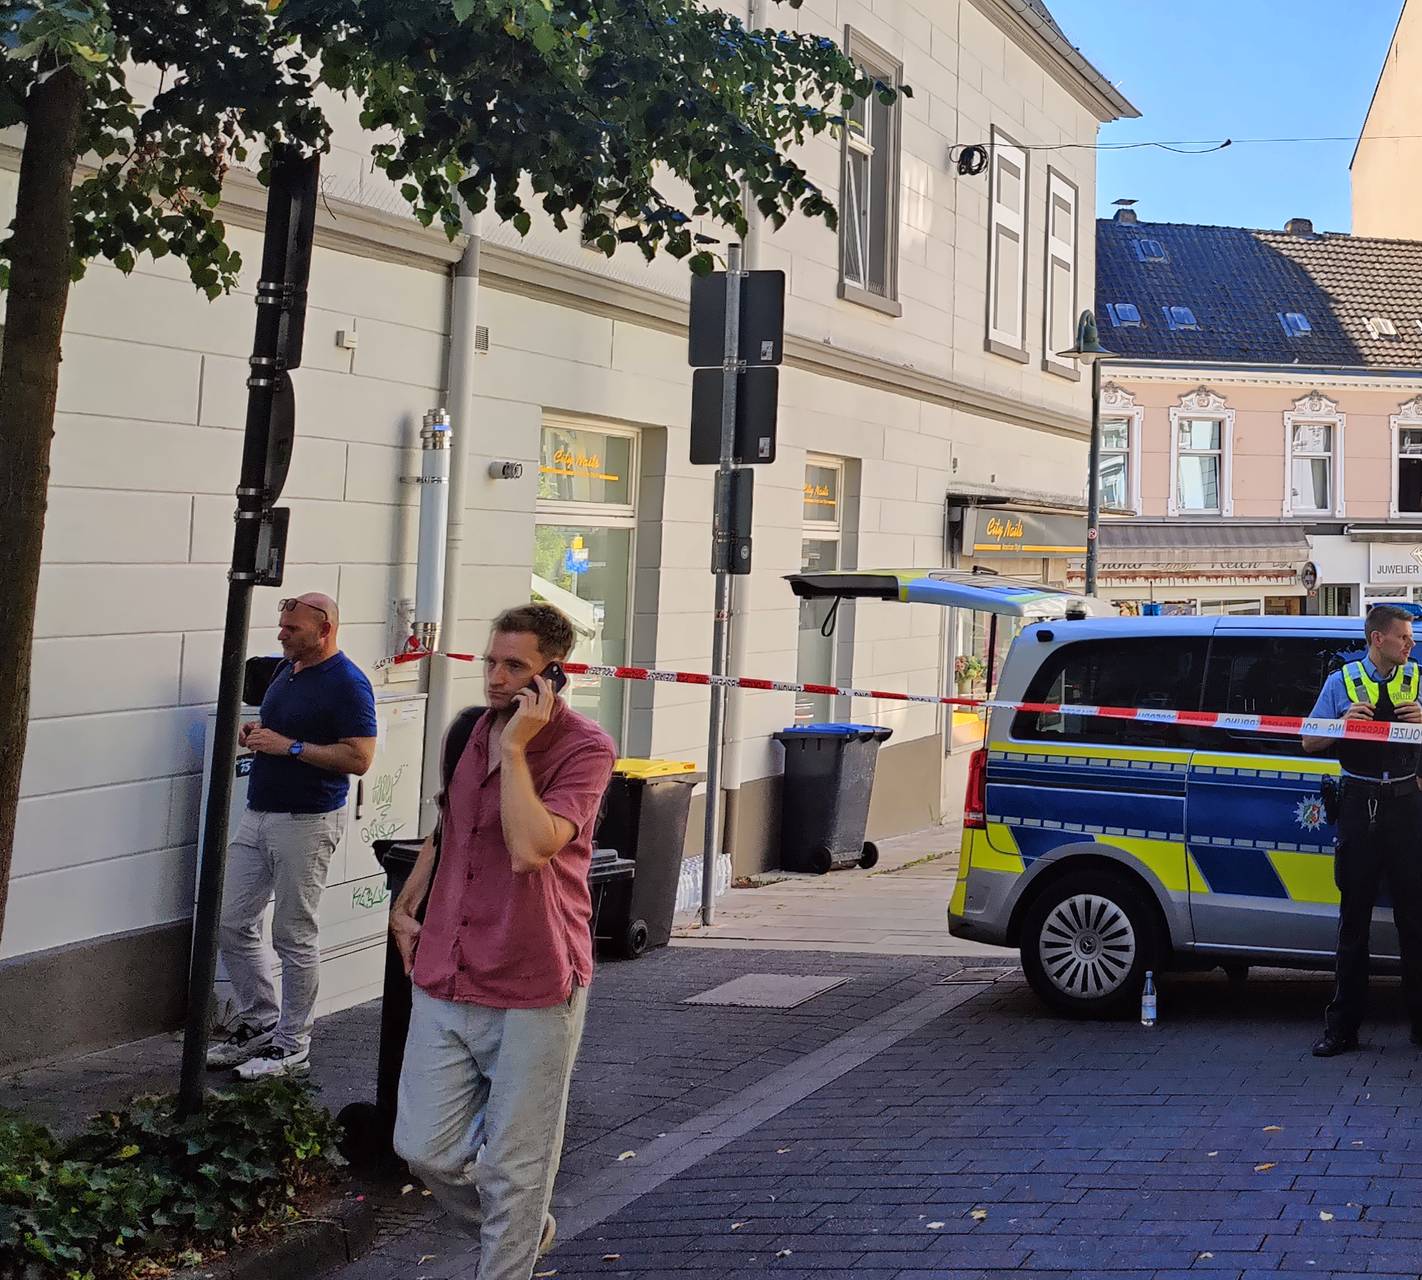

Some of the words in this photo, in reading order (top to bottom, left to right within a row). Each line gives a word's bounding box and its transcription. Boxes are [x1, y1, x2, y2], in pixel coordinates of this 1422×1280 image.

[986, 517, 1003, 542] City
[1003, 519, 1024, 538] Nails
[1377, 565, 1419, 575] JUWELIER
